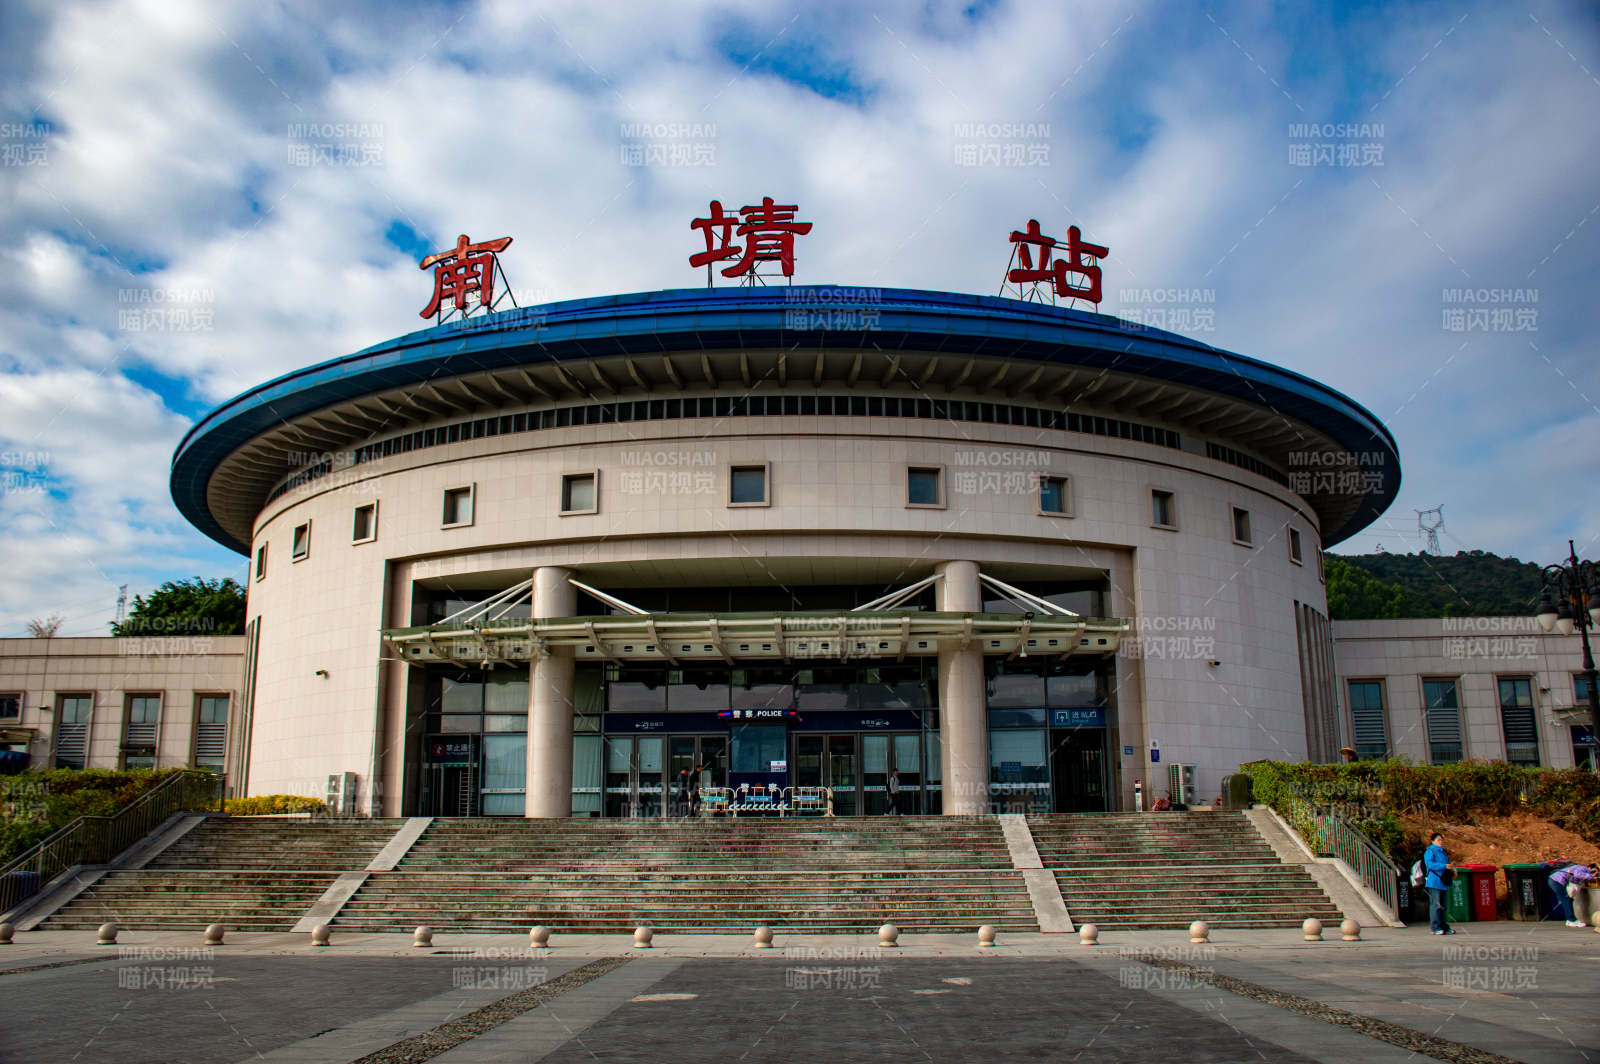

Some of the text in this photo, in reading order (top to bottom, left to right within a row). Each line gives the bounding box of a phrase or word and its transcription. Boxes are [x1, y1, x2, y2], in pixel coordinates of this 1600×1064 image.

[420, 198, 1109, 318] 南 靖 站
